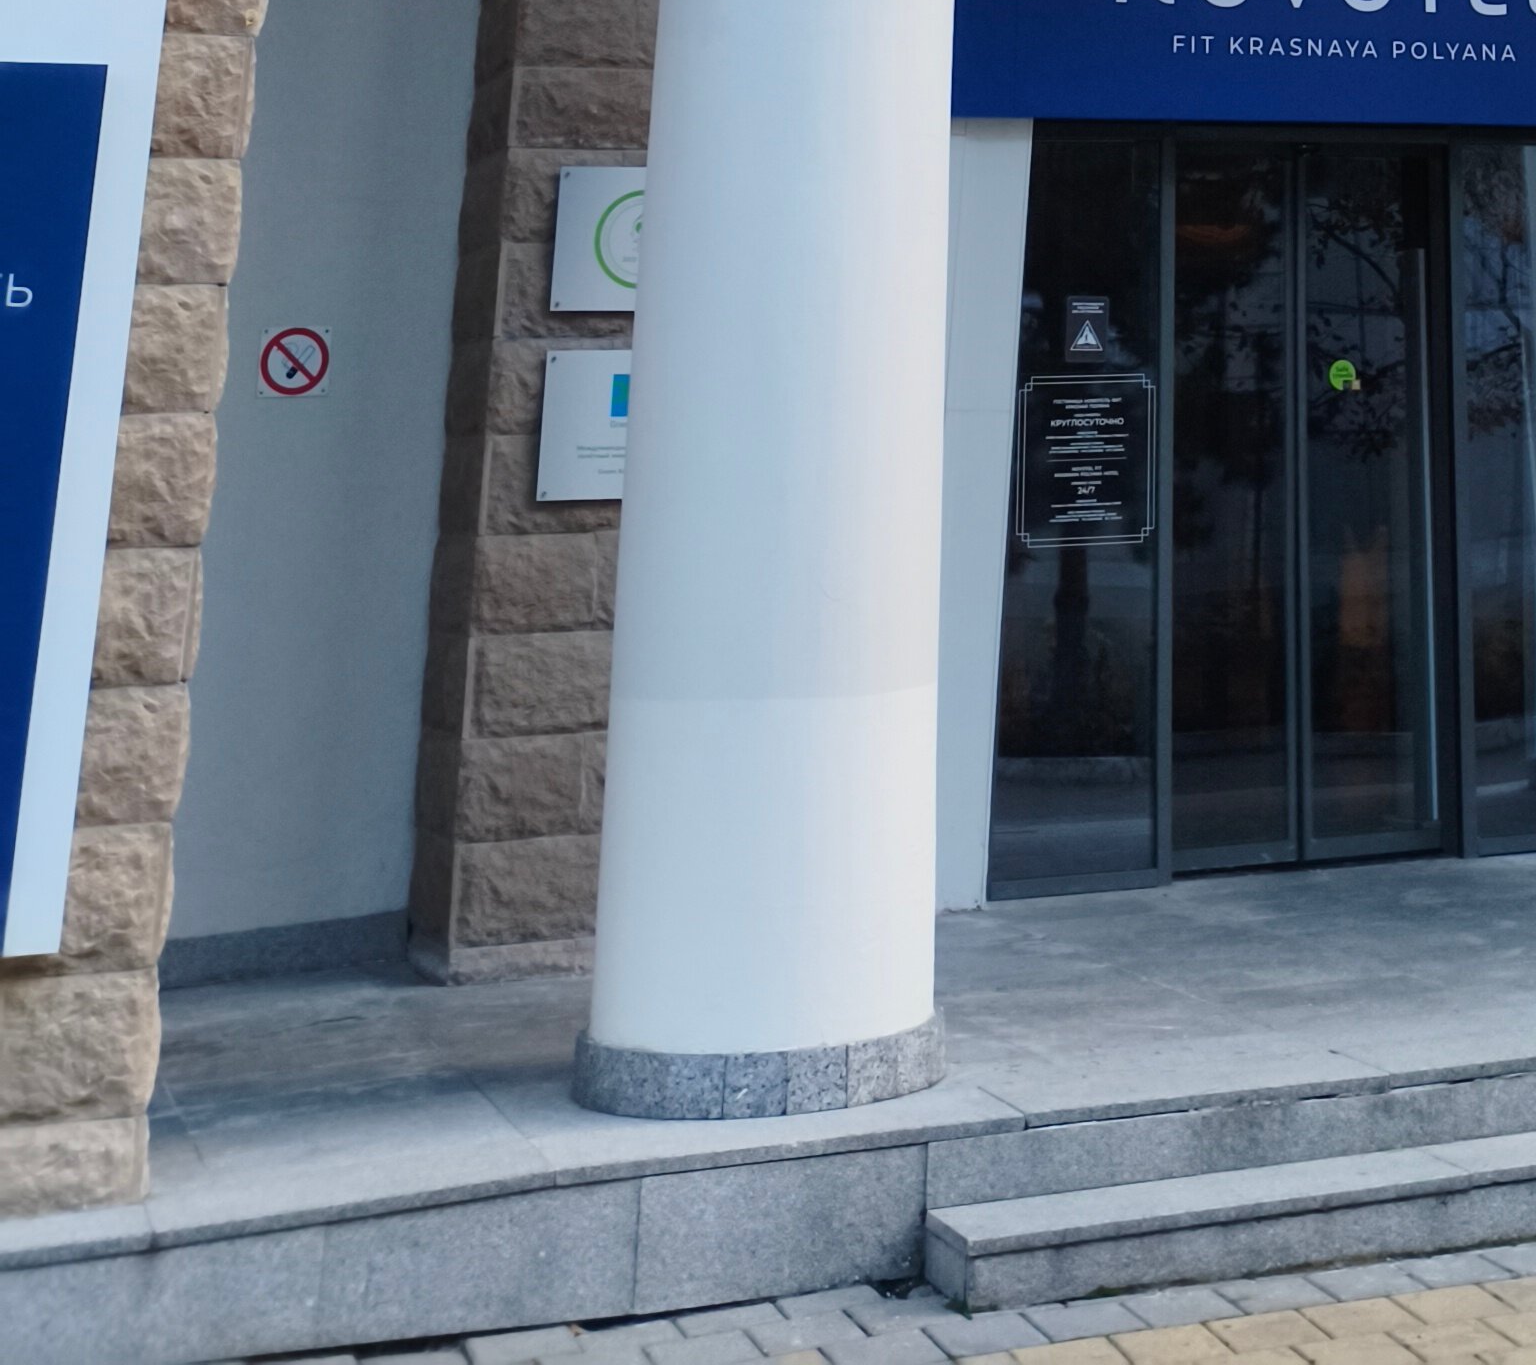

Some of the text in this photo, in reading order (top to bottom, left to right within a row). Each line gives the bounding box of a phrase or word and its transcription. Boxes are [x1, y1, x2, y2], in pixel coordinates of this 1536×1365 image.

[1172, 35, 1517, 62] FIT KRASNAYA POLYANA
[1050, 417, 1125, 428] КРУГЛОСУТОЧНО
